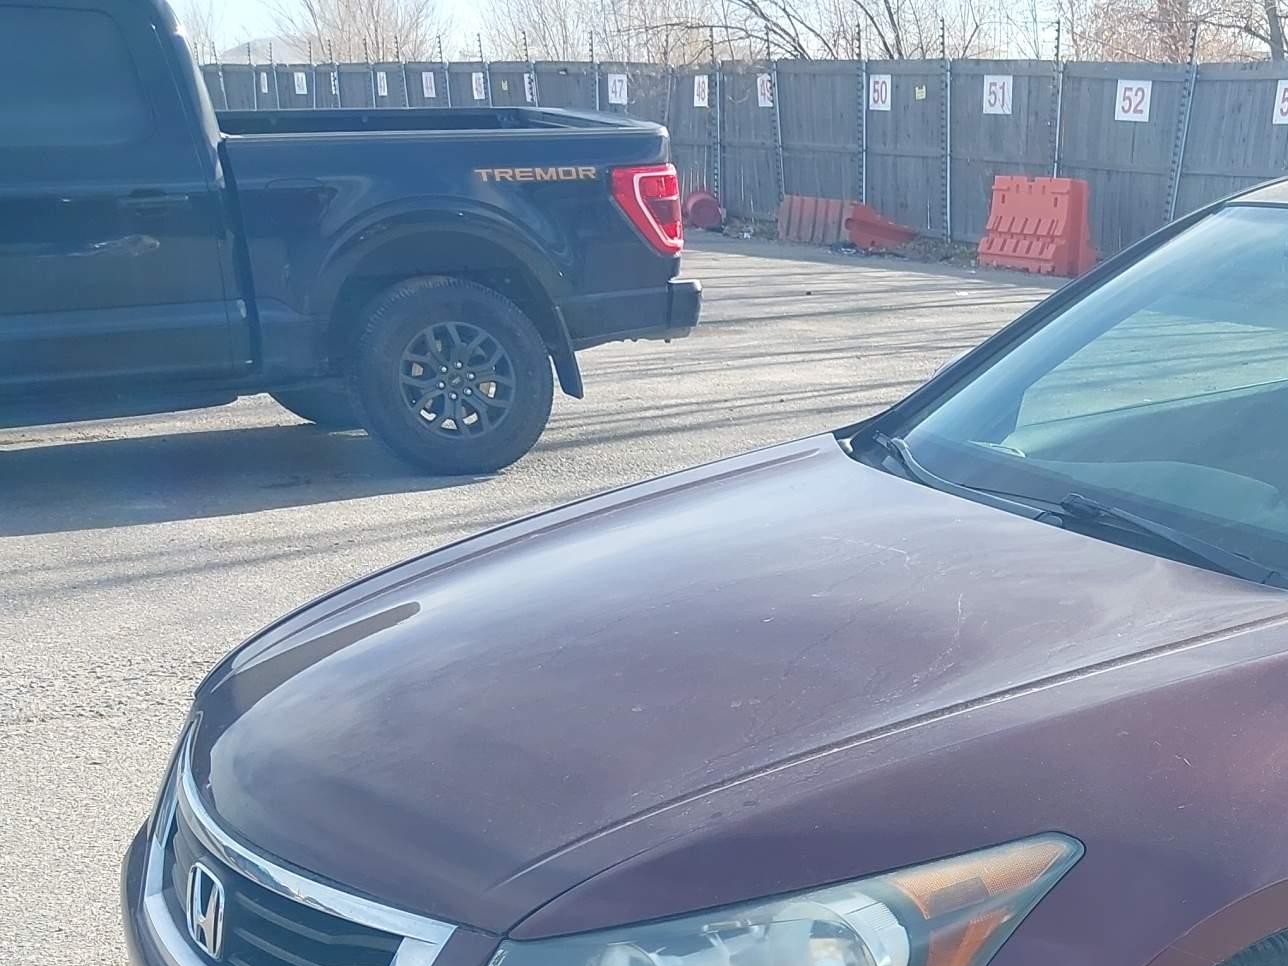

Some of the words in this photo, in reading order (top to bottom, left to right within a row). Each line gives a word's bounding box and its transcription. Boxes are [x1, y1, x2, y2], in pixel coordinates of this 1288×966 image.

[610, 78, 624, 99] 47
[696, 77, 706, 102] 48
[872, 80, 888, 104] 50
[987, 81, 1007, 108] 51
[1120, 86, 1146, 115] 52
[473, 166, 598, 182] TREMOR
